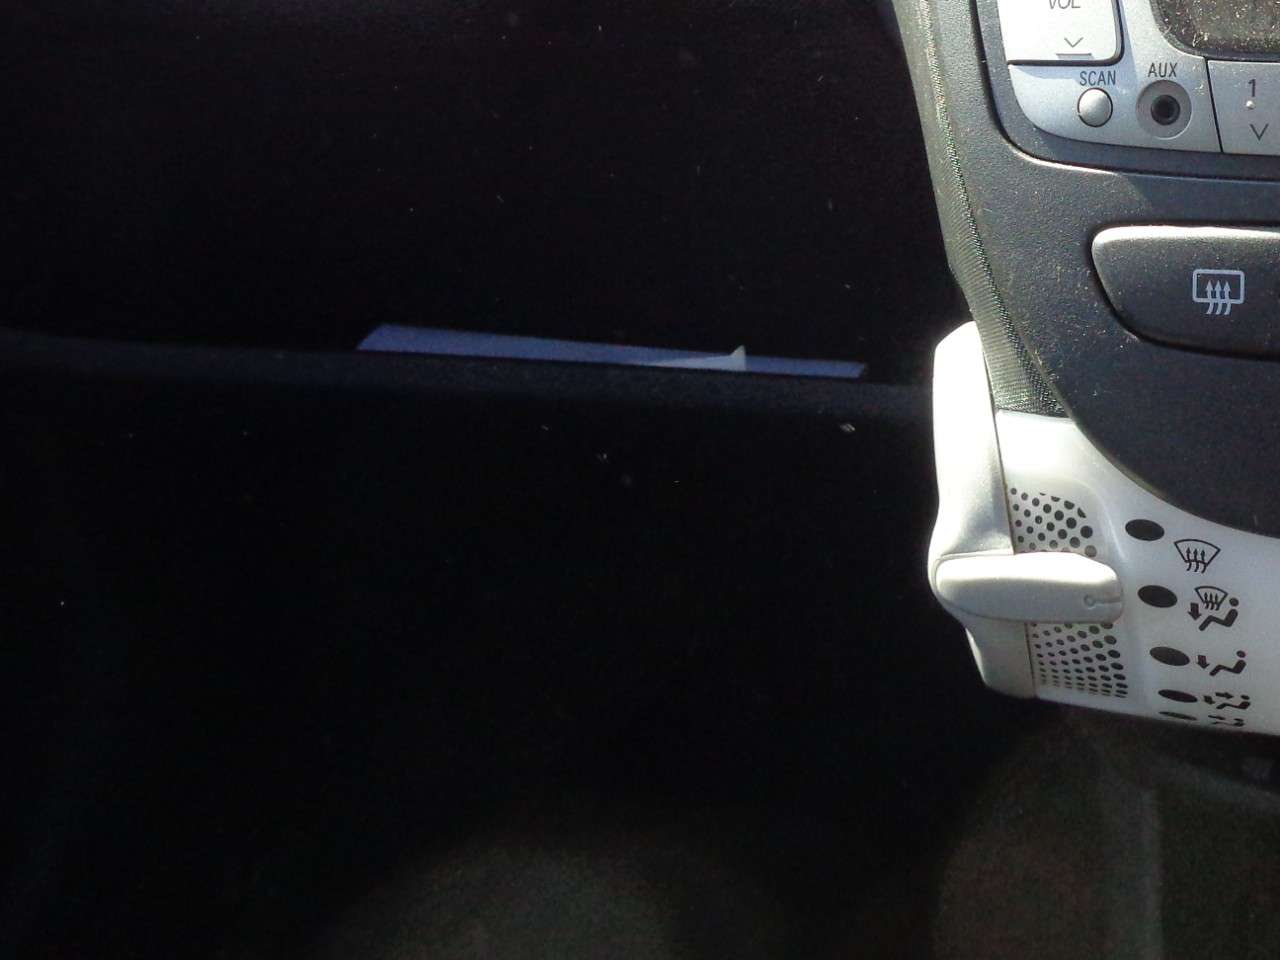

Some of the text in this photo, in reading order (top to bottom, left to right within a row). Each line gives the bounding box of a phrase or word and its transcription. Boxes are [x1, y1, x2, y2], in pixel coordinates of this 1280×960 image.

[1147, 62, 1178, 77] AUX
[1079, 70, 1116, 87] SCAN
[1247, 79, 1257, 97] 1
